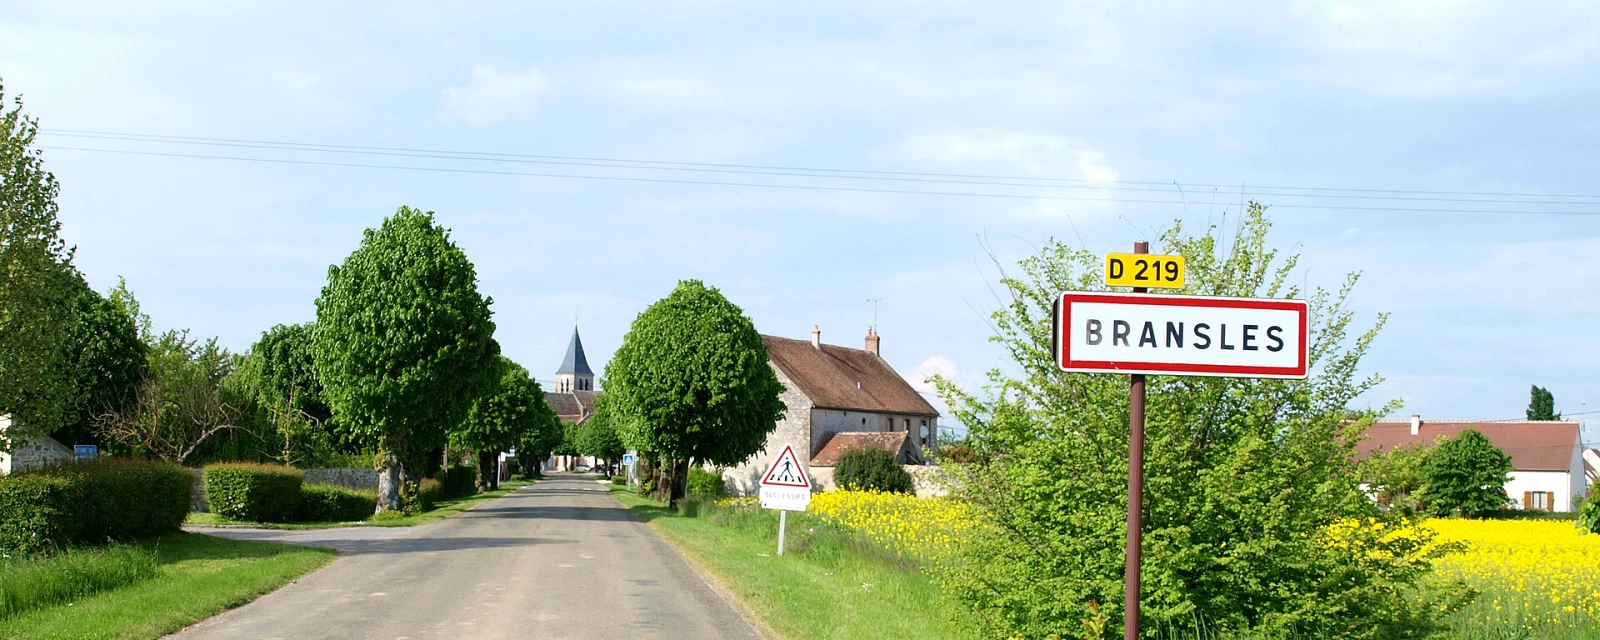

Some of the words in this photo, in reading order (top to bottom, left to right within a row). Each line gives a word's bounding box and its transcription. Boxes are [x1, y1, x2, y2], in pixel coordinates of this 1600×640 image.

[1109, 258, 1124, 280] D
[1134, 259, 1179, 282] 219
[1086, 318, 1284, 353] BRANSLES
[765, 491, 806, 501] SUCCESSIFS
